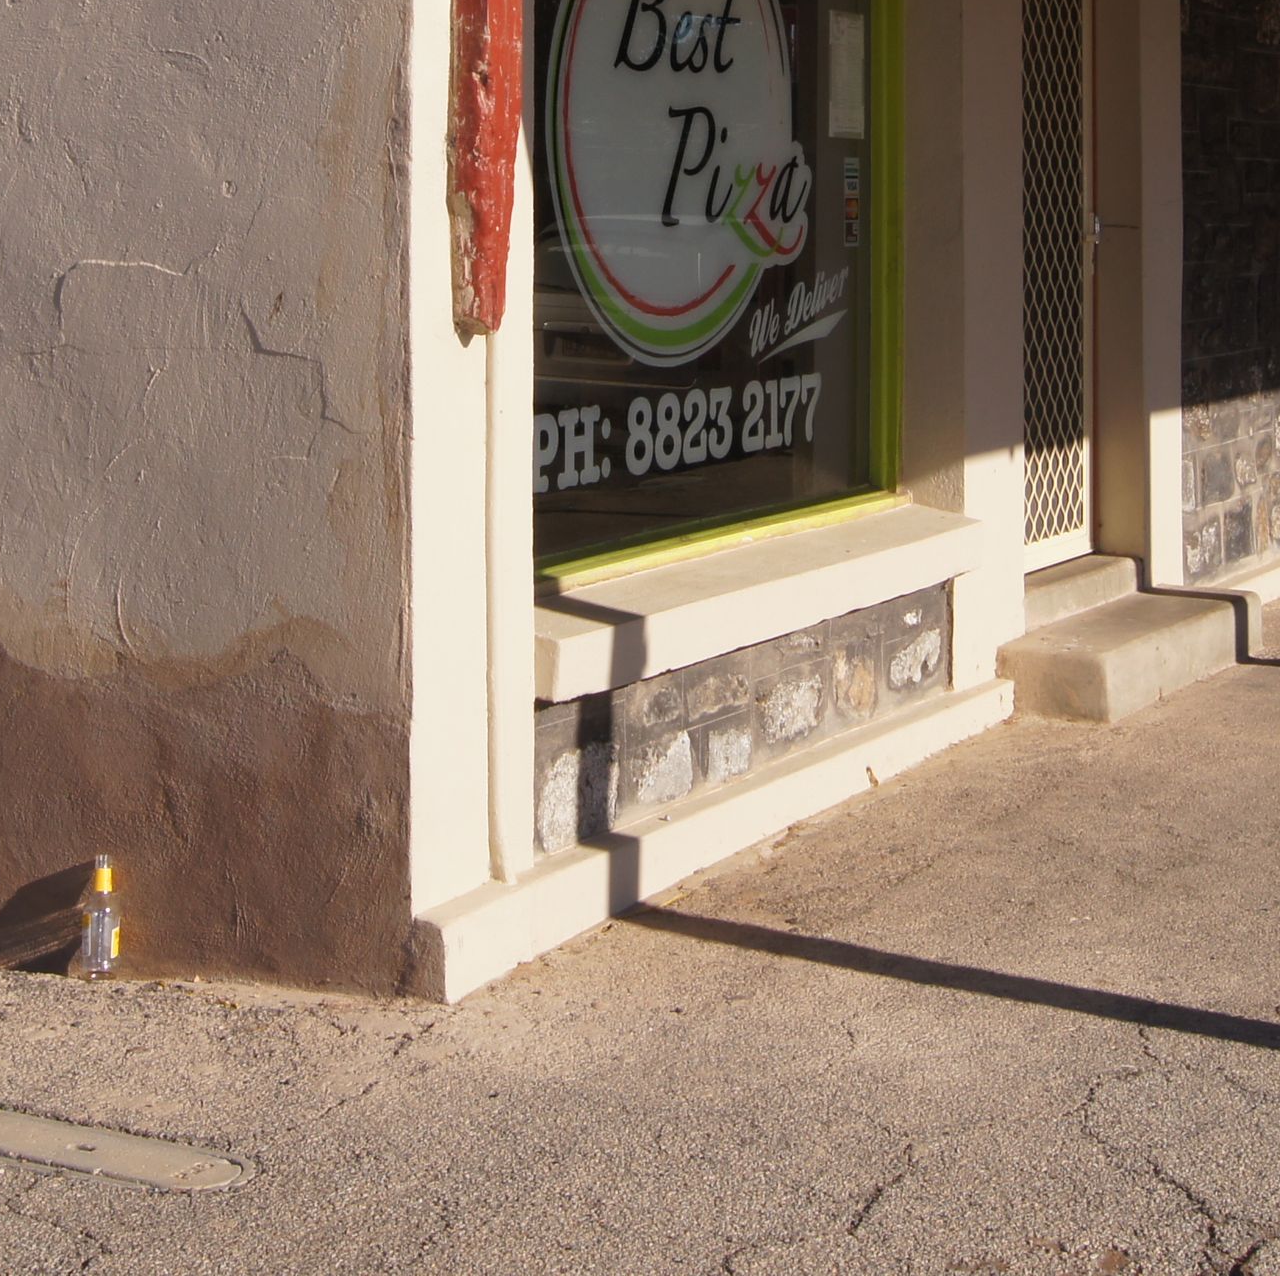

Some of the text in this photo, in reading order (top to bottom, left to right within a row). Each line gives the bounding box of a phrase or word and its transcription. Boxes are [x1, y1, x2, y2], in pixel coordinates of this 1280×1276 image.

[660, 105, 808, 258] Pizza
[749, 266, 849, 357] We Deliver
[534, 373, 822, 494] PH: 8823 2177
